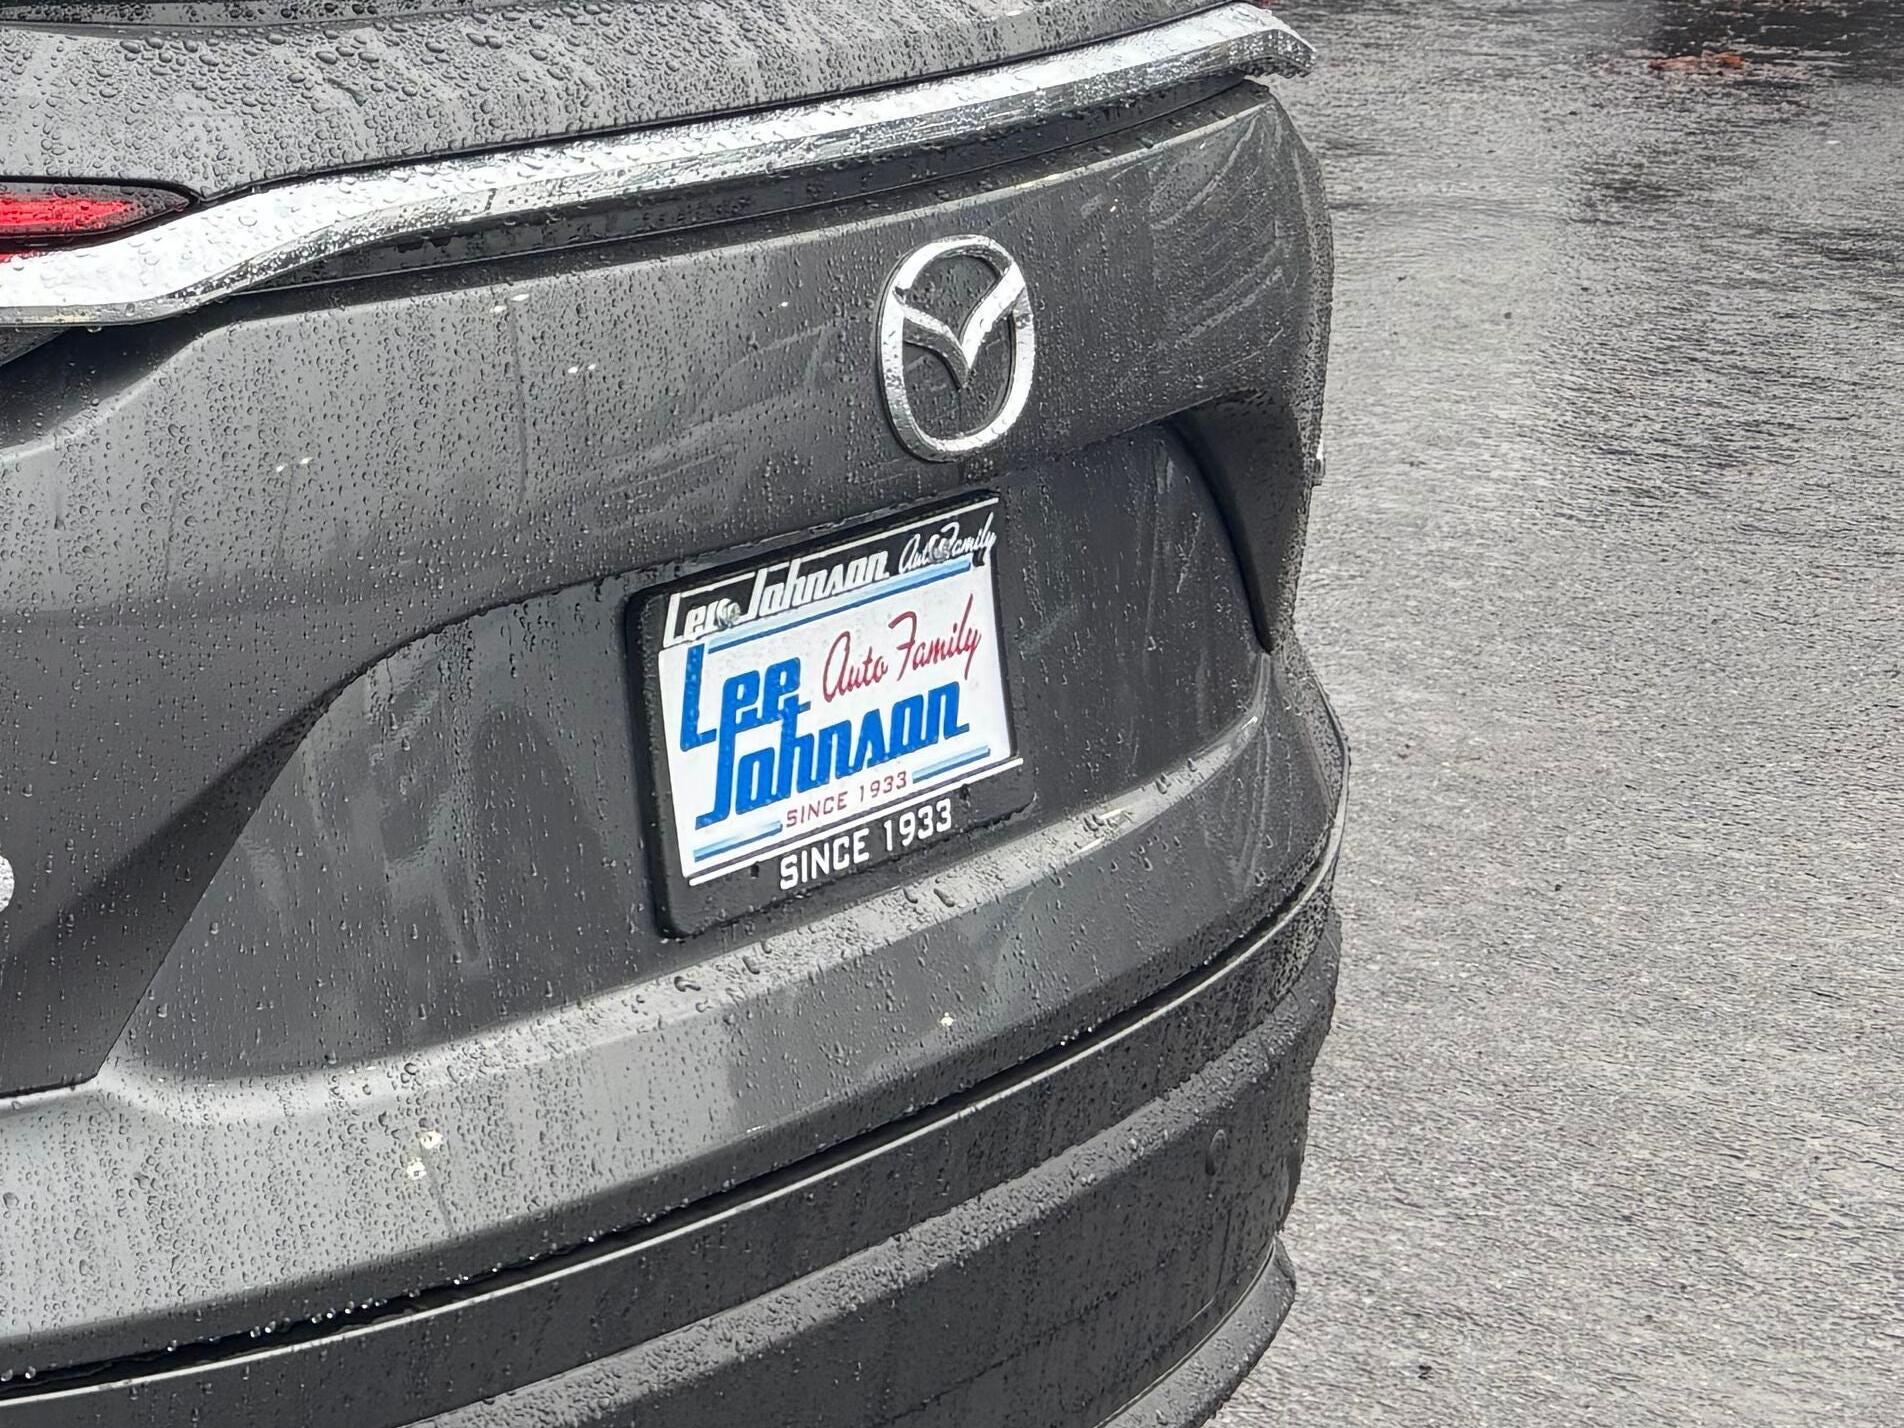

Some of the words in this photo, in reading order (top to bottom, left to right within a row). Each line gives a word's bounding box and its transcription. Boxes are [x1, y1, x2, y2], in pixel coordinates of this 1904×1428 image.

[737, 550, 891, 621] Johnson
[680, 644, 810, 753] Lee
[823, 630, 889, 703] Auto
[888, 593, 982, 681] Family
[694, 681, 971, 830] Johnson
[786, 791, 849, 828] SINCE
[859, 771, 908, 803] 1933
[779, 828, 870, 891] SINCE
[882, 798, 953, 852] 1933
